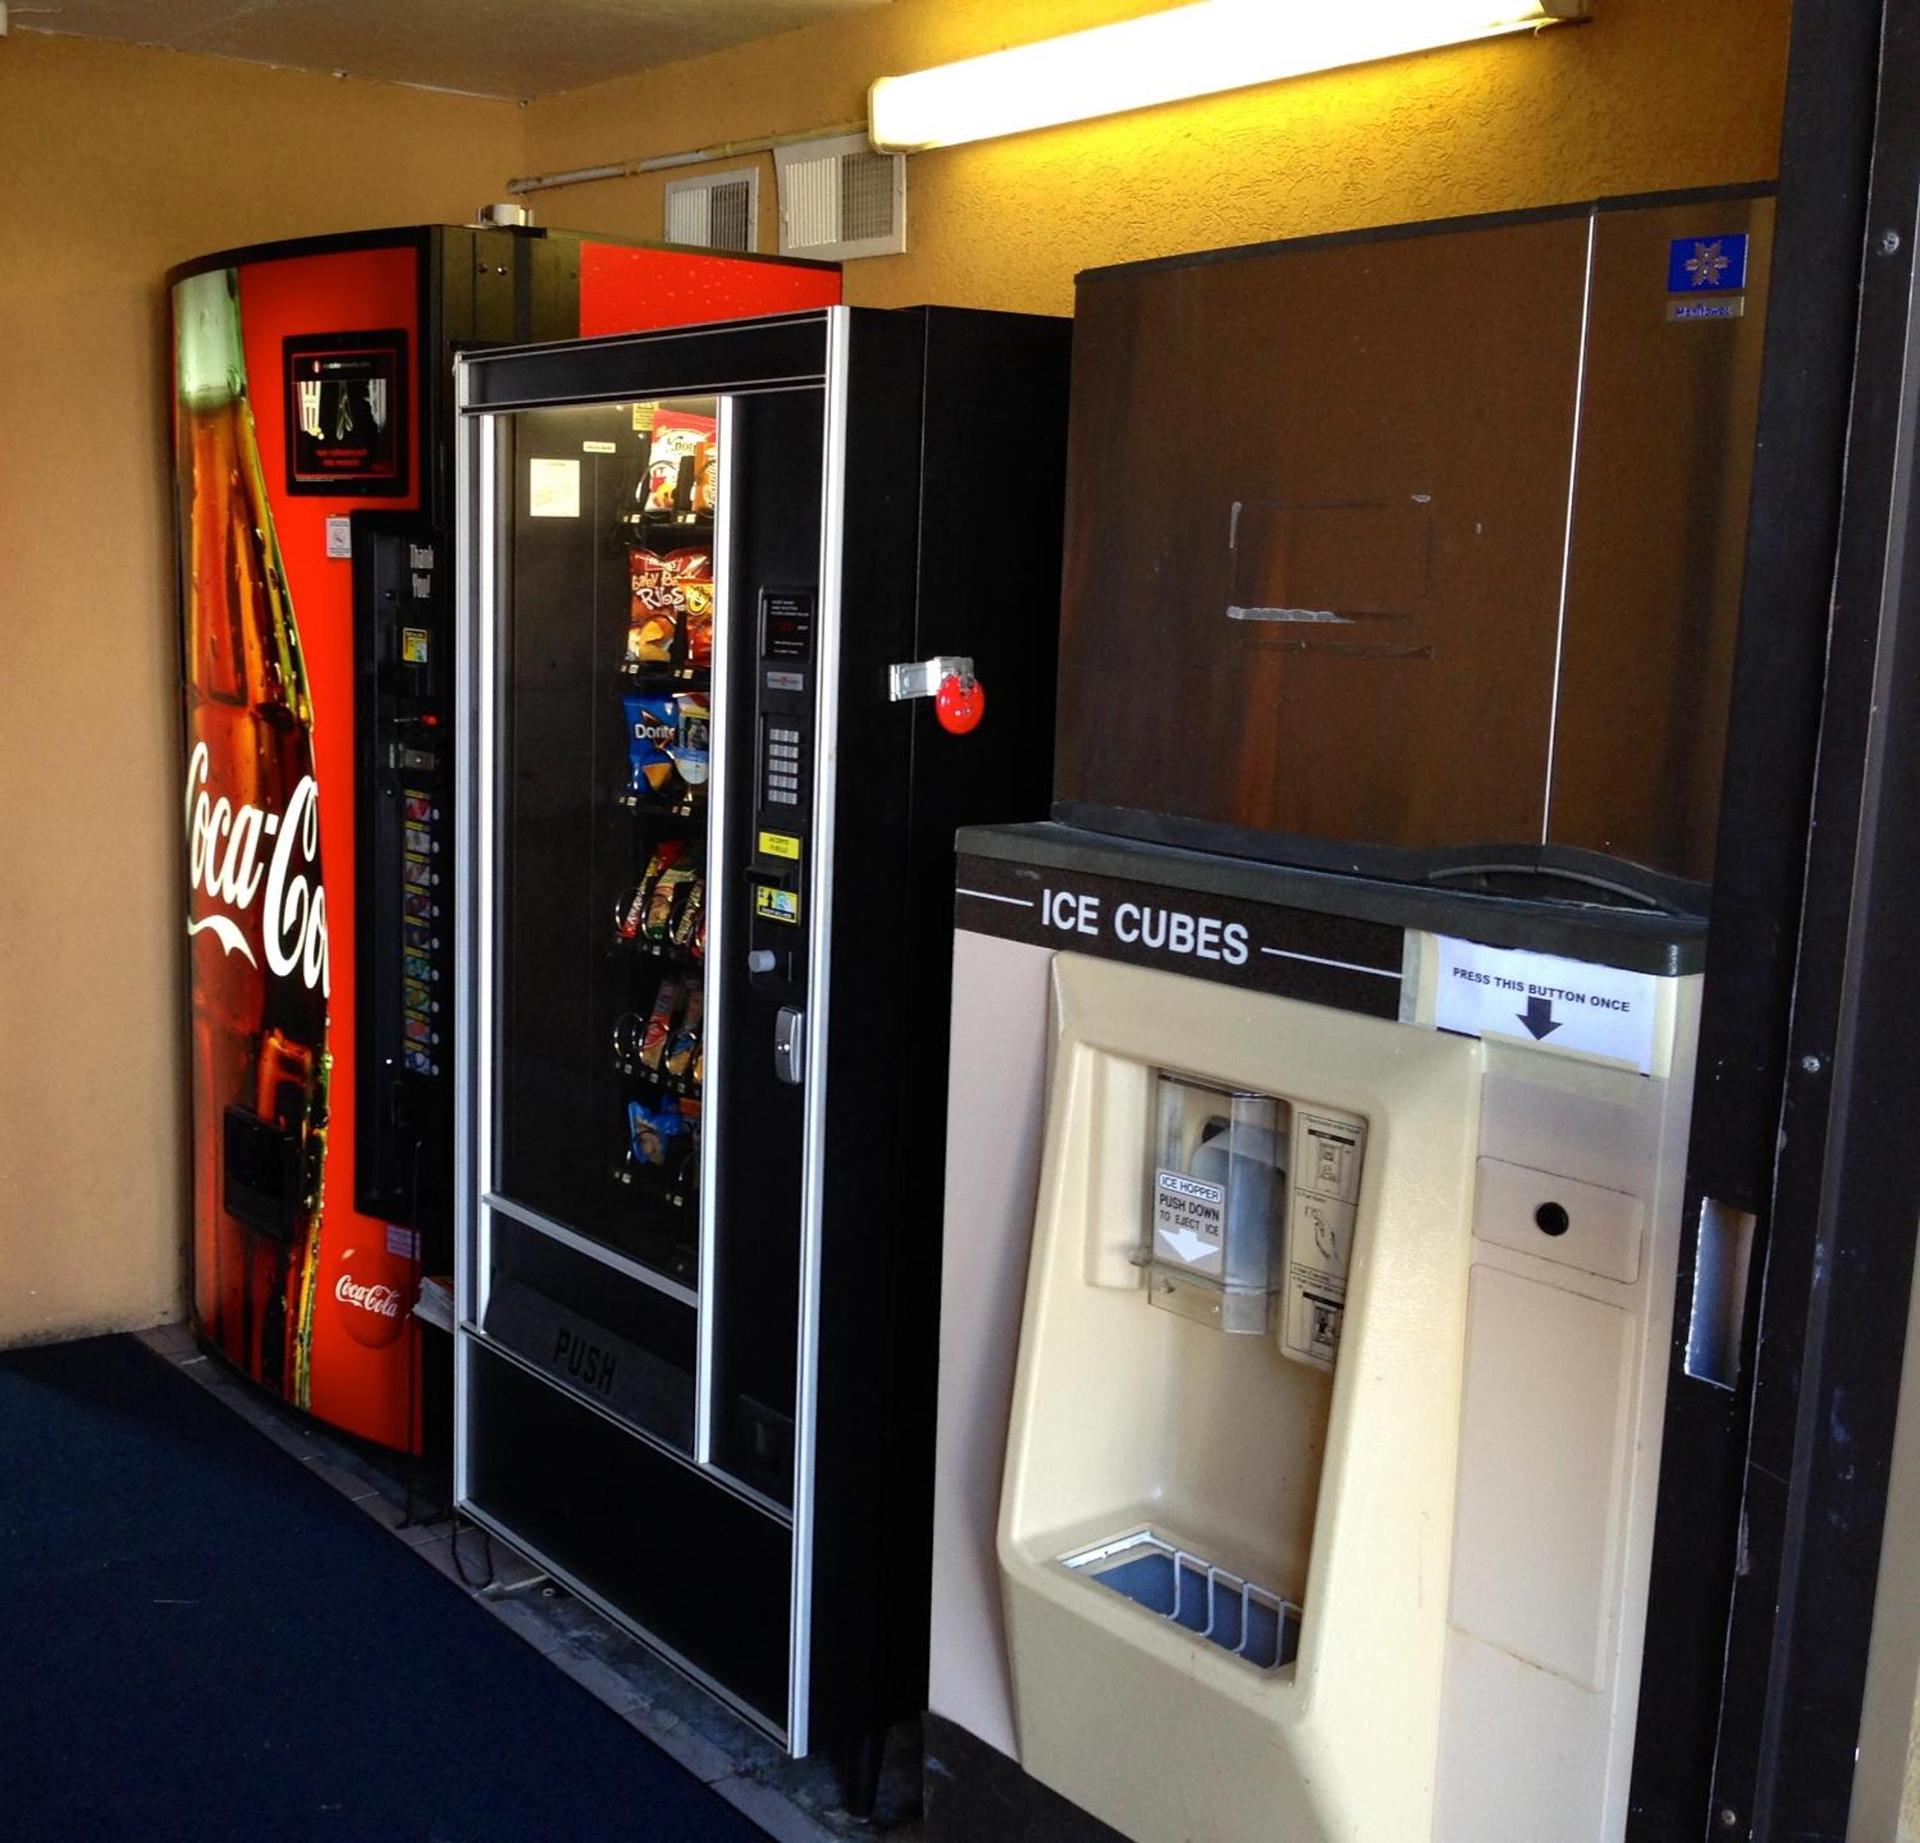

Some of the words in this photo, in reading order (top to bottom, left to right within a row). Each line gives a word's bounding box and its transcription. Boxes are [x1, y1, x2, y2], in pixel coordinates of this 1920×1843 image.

[1041, 888, 1100, 936] ICE
[1114, 902, 1249, 966] CUBES
[1452, 966, 1491, 985] PRESS
[1494, 976, 1525, 992] THIS
[1528, 983, 1586, 1004] BUTTON
[1590, 995, 1631, 1013] ONCE
[1159, 1193, 1186, 1212] PUSH
[1188, 1201, 1220, 1222] DOWN
[1161, 1175, 1178, 1190] ICE
[1180, 1180, 1219, 1200] HOPPER
[1160, 1209, 1171, 1222] TO
[1175, 1213, 1200, 1231] EJECT
[1205, 1223, 1219, 1237] ICE
[335, 1274, 400, 1318] Coca-Cola
[553, 1327, 617, 1395] PUSH
